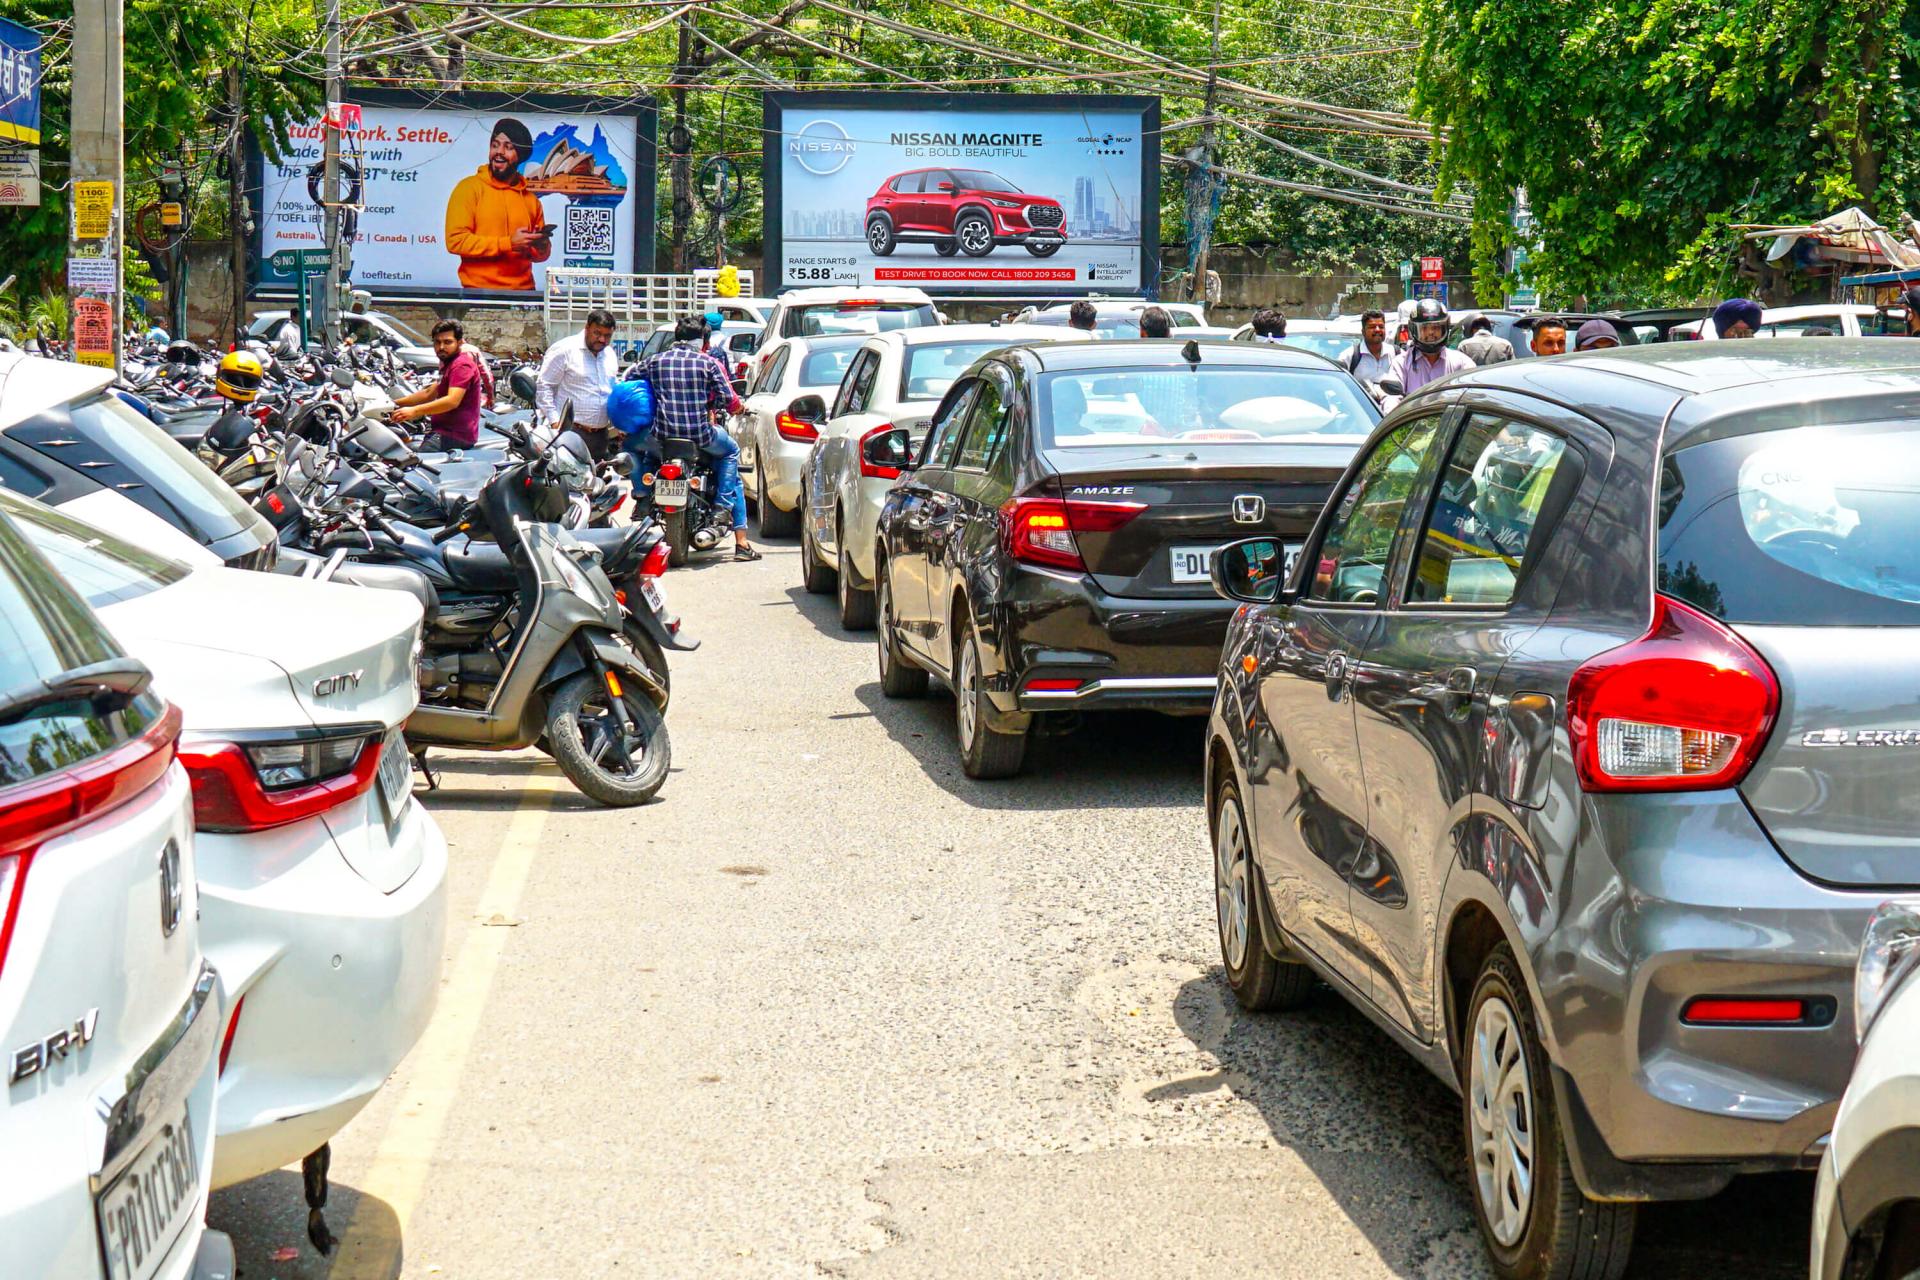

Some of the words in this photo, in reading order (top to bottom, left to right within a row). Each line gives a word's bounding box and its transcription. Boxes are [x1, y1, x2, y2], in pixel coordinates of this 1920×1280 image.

[289, 122, 328, 142] tudy
[396, 127, 453, 144] Settle.
[891, 132, 957, 146] NISSAN
[961, 133, 1043, 147] MAGNITE
[789, 141, 857, 152] NISSAN
[905, 147, 928, 157] BIG.
[929, 147, 961, 157] BOLD.
[370, 147, 402, 161] with
[277, 165, 301, 178] the
[390, 168, 418, 182] test
[277, 201, 304, 212] 100%
[363, 205, 396, 215] accept
[277, 214, 306, 223] TOEFL
[308, 215, 324, 224] iBT
[275, 230, 316, 241] Australia
[373, 233, 408, 243] Canada
[418, 235, 437, 244] USA
[282, 255, 295, 266] NO
[304, 254, 331, 265] SMOKING
[789, 257, 817, 265] RANGE
[818, 257, 847, 265] STARTS
[848, 258, 857, 266] @
[361, 270, 412, 281] toefltest.in
[834, 273, 857, 281] LAKH
[880, 270, 900, 278] TEST
[902, 270, 926, 278] DRIVE
[929, 270, 941, 278] TO
[942, 270, 966, 278] BOOK
[991, 270, 1012, 279] CALL
[1014, 271, 1033, 279] 1800
[1035, 271, 1050, 279] 209
[1072, 486, 1136, 495] AMAZE
[312, 668, 365, 697] CITY
[1801, 729, 1920, 747] CELERIO
[8, 1006, 99, 1087] BR-V
